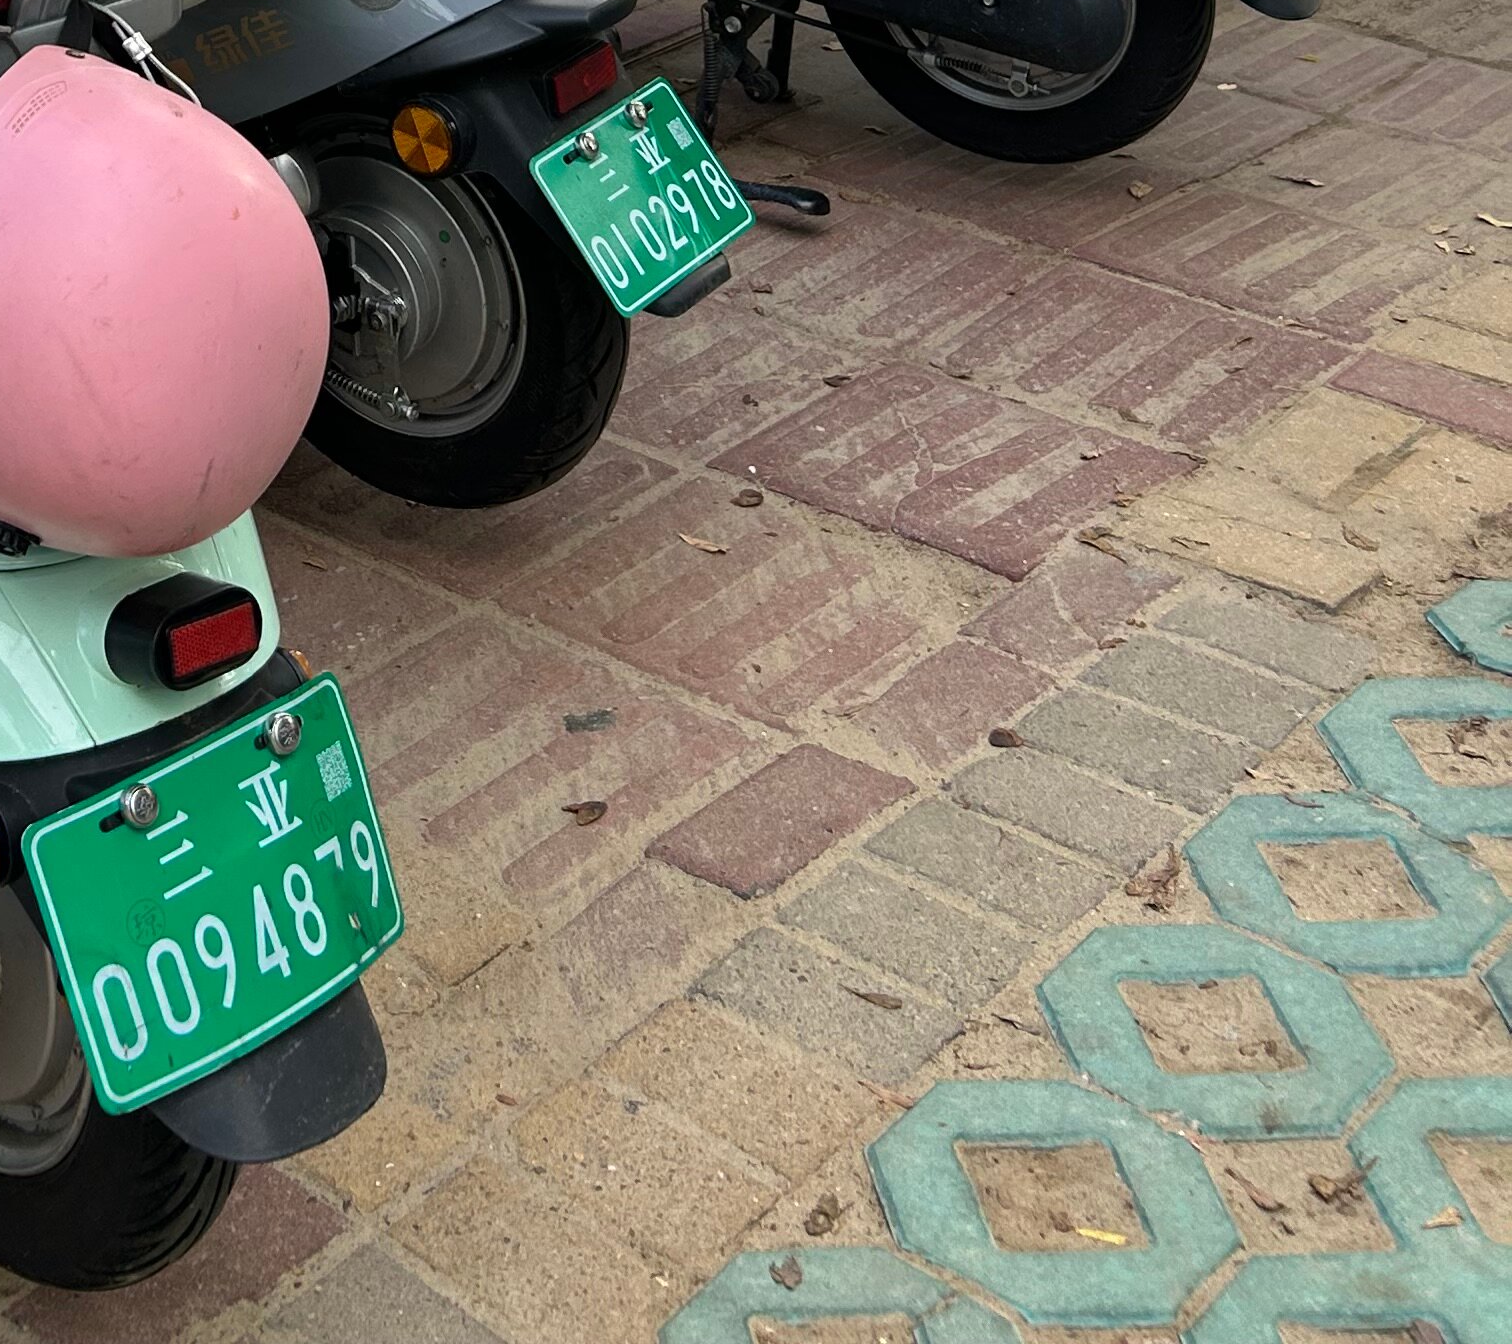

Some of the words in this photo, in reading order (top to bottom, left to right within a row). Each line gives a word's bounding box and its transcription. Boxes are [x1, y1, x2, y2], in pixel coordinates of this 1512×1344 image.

[194, 8, 295, 72] 绿佳
[588, 127, 672, 202] 三亚
[591, 159, 737, 290] 0102978
[146, 760, 304, 901] 三亚
